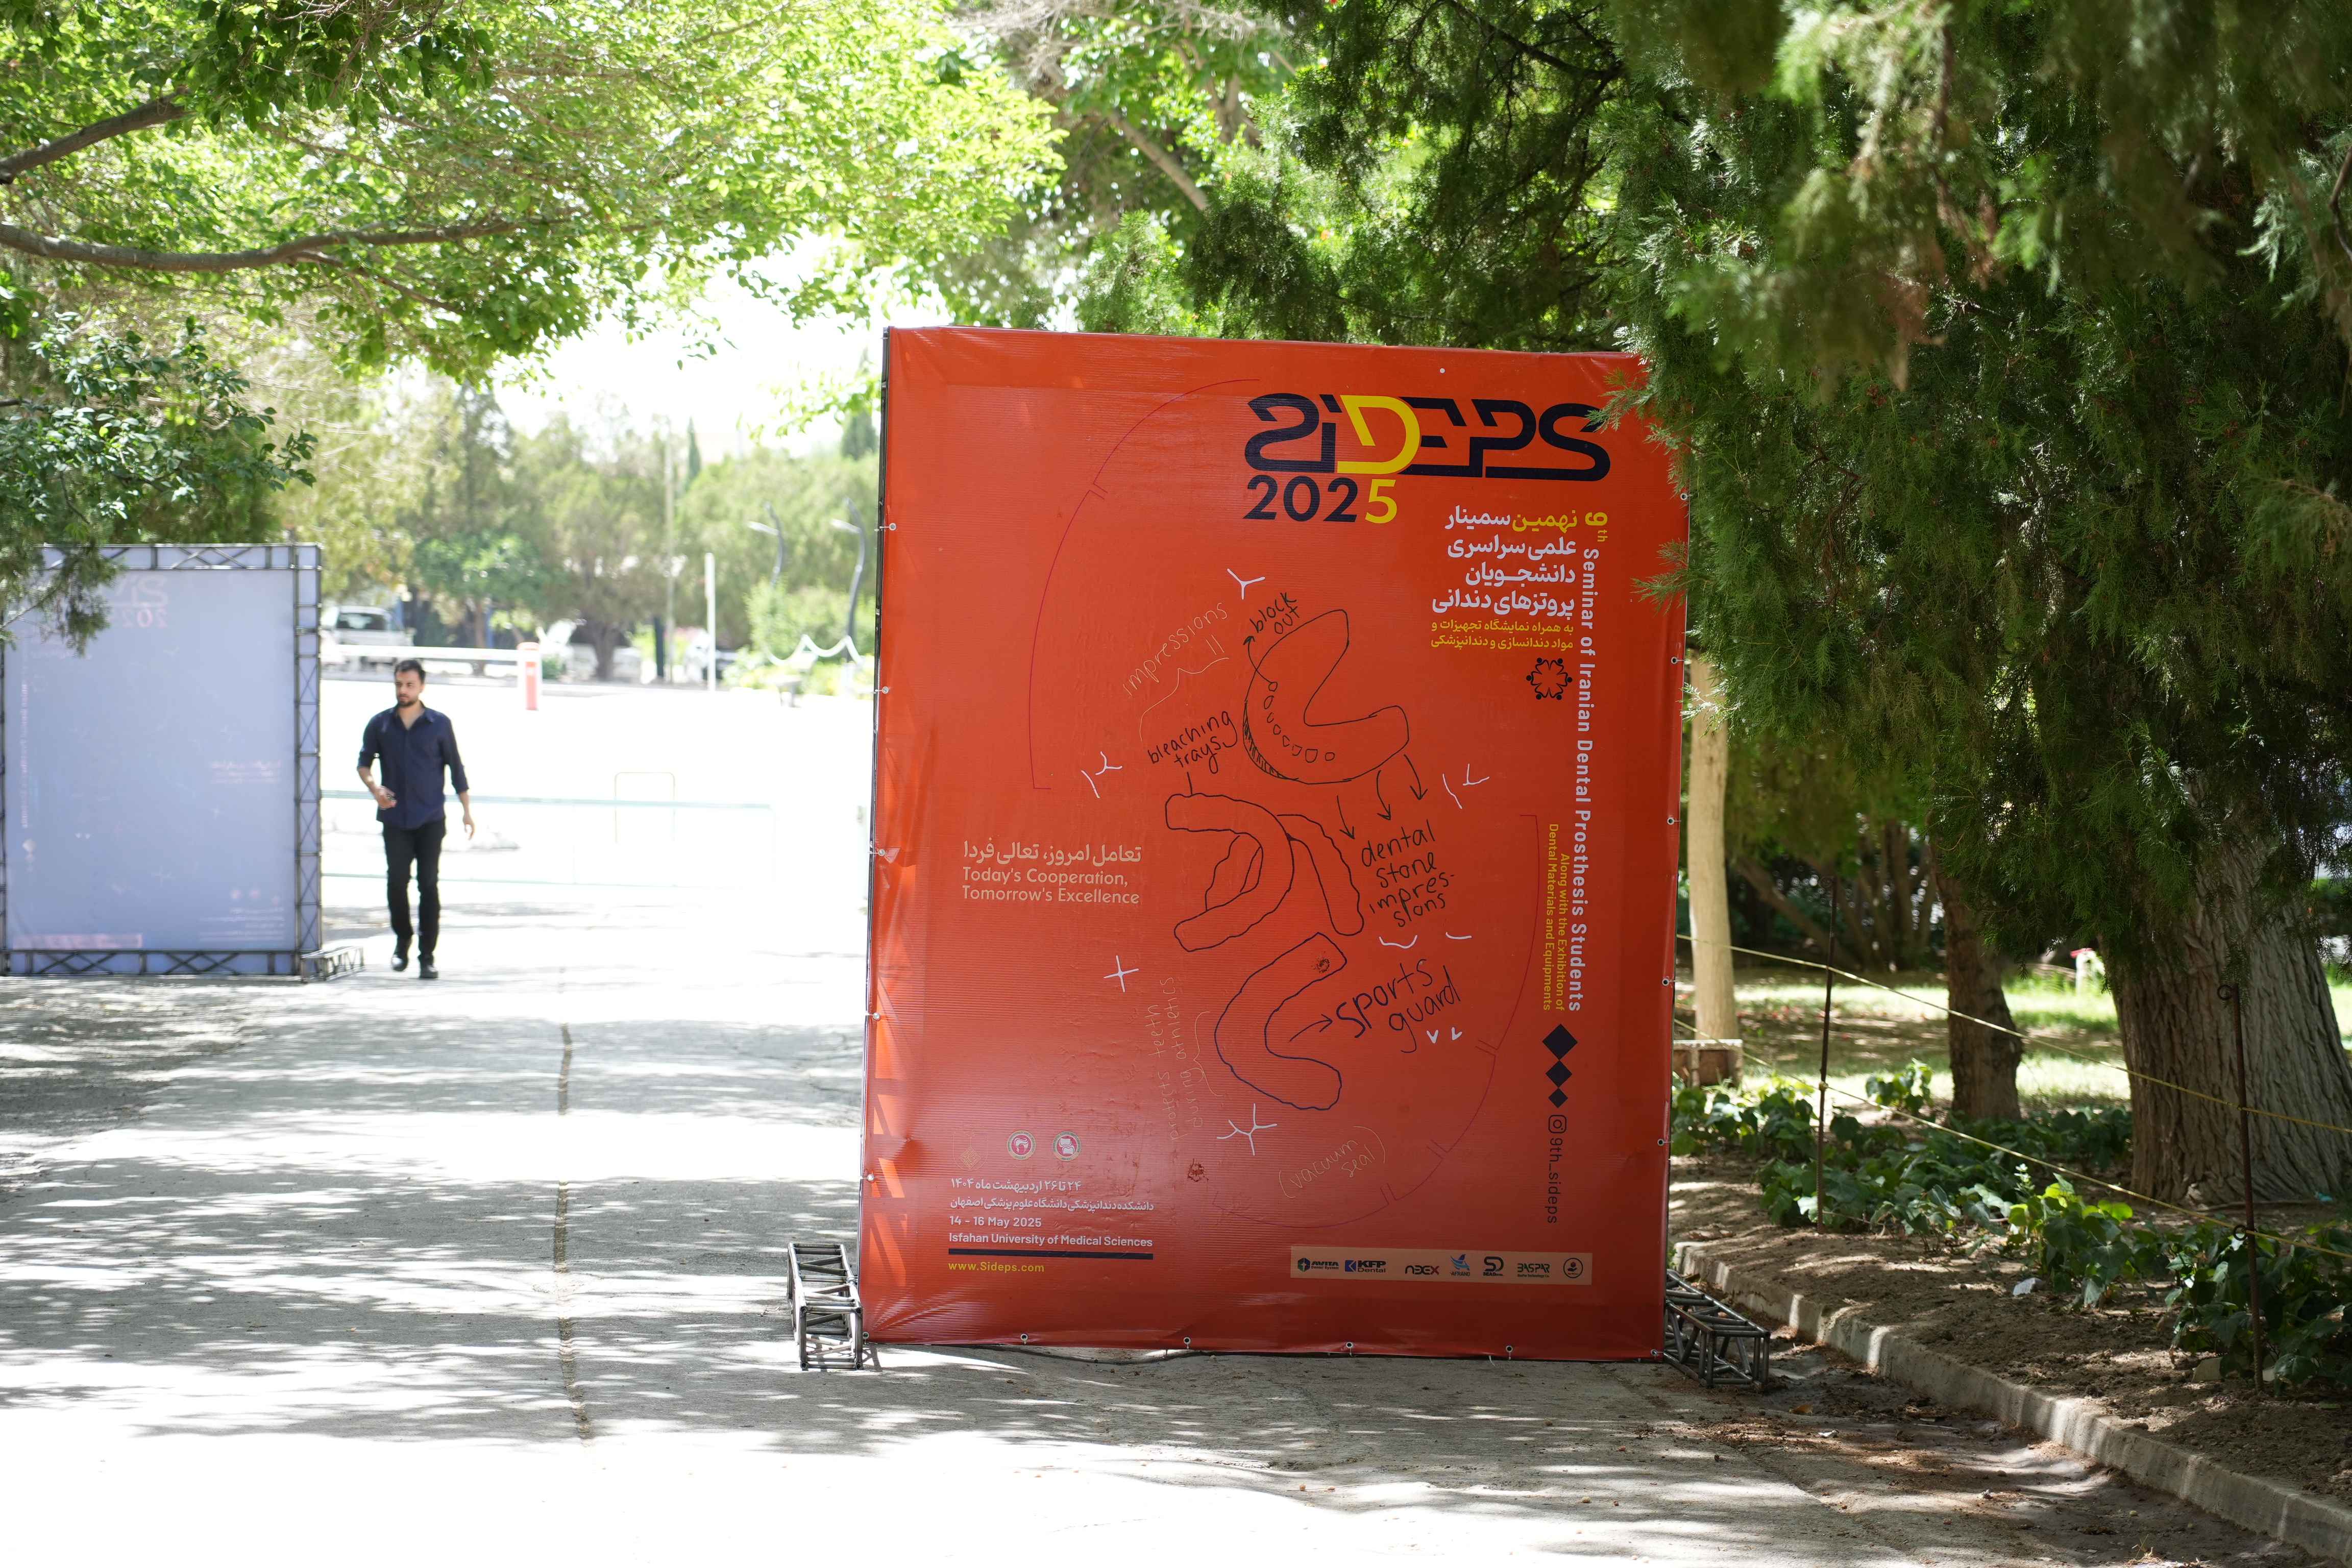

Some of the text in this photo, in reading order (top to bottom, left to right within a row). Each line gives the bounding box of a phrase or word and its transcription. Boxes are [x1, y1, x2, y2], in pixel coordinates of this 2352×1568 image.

[1242, 475, 1397, 524] 2025
[1444, 505, 1577, 534] نهمین سمینار
[1448, 534, 1576, 561] علمی سراسری
[1465, 561, 1576, 587] دانشجویان
[1581, 549, 1599, 629] Seminar
[1249, 592, 1297, 633] block
[1432, 588, 1575, 621] پروتزهای دندانی
[1273, 606, 1300, 634] out
[1431, 619, 1574, 635] به همراه نمایشگاه تجهیزات و
[1122, 602, 1228, 696] impressions
[1431, 634, 1573, 651] مواد دندانسازی و دندانپزشکی
[1580, 636, 1596, 656] of
[1578, 664, 1596, 731] Iranian
[1148, 711, 1238, 764] bleaching
[1173, 736, 1221, 775] trays
[1576, 740, 1593, 802] Dental
[964, 837, 994, 864] فردا
[996, 842, 1039, 865] تعالی
[1092, 844, 1142, 867] تعامل
[1361, 819, 1436, 867] dental
[963, 866, 1128, 888] Today's Cooperation,
[1376, 852, 1436, 888] stone
[1572, 810, 1591, 916] Prosthesis
[962, 885, 1140, 904] Tomorrow's Excellence
[1542, 824, 1559, 1011] Dental Materials and Equipments
[1555, 853, 1570, 1011] Along with the Exhibition of
[1569, 923, 1587, 1011] Students
[1336, 959, 1433, 1038] sports
[1388, 965, 1461, 1053] guard
[975, 1179, 991, 1190] ماه
[992, 1179, 1043, 1195] اردیبهشت
[1545, 1138, 1563, 1223] 9th_sideps
[950, 1196, 1154, 1213] دانشکده دندانپزشکی دانشگاه علوم پزشکی اصفهان
[949, 1216, 962, 1226] 14
[973, 1216, 985, 1227] 16
[988, 1216, 1012, 1230] May
[1013, 1217, 1042, 1228] 2025
[949, 1232, 1153, 1247] Isfahan University of Medical Sciences
[948, 1261, 1044, 1273] www.Sideps.com
[1358, 1260, 1386, 1269] KFP
